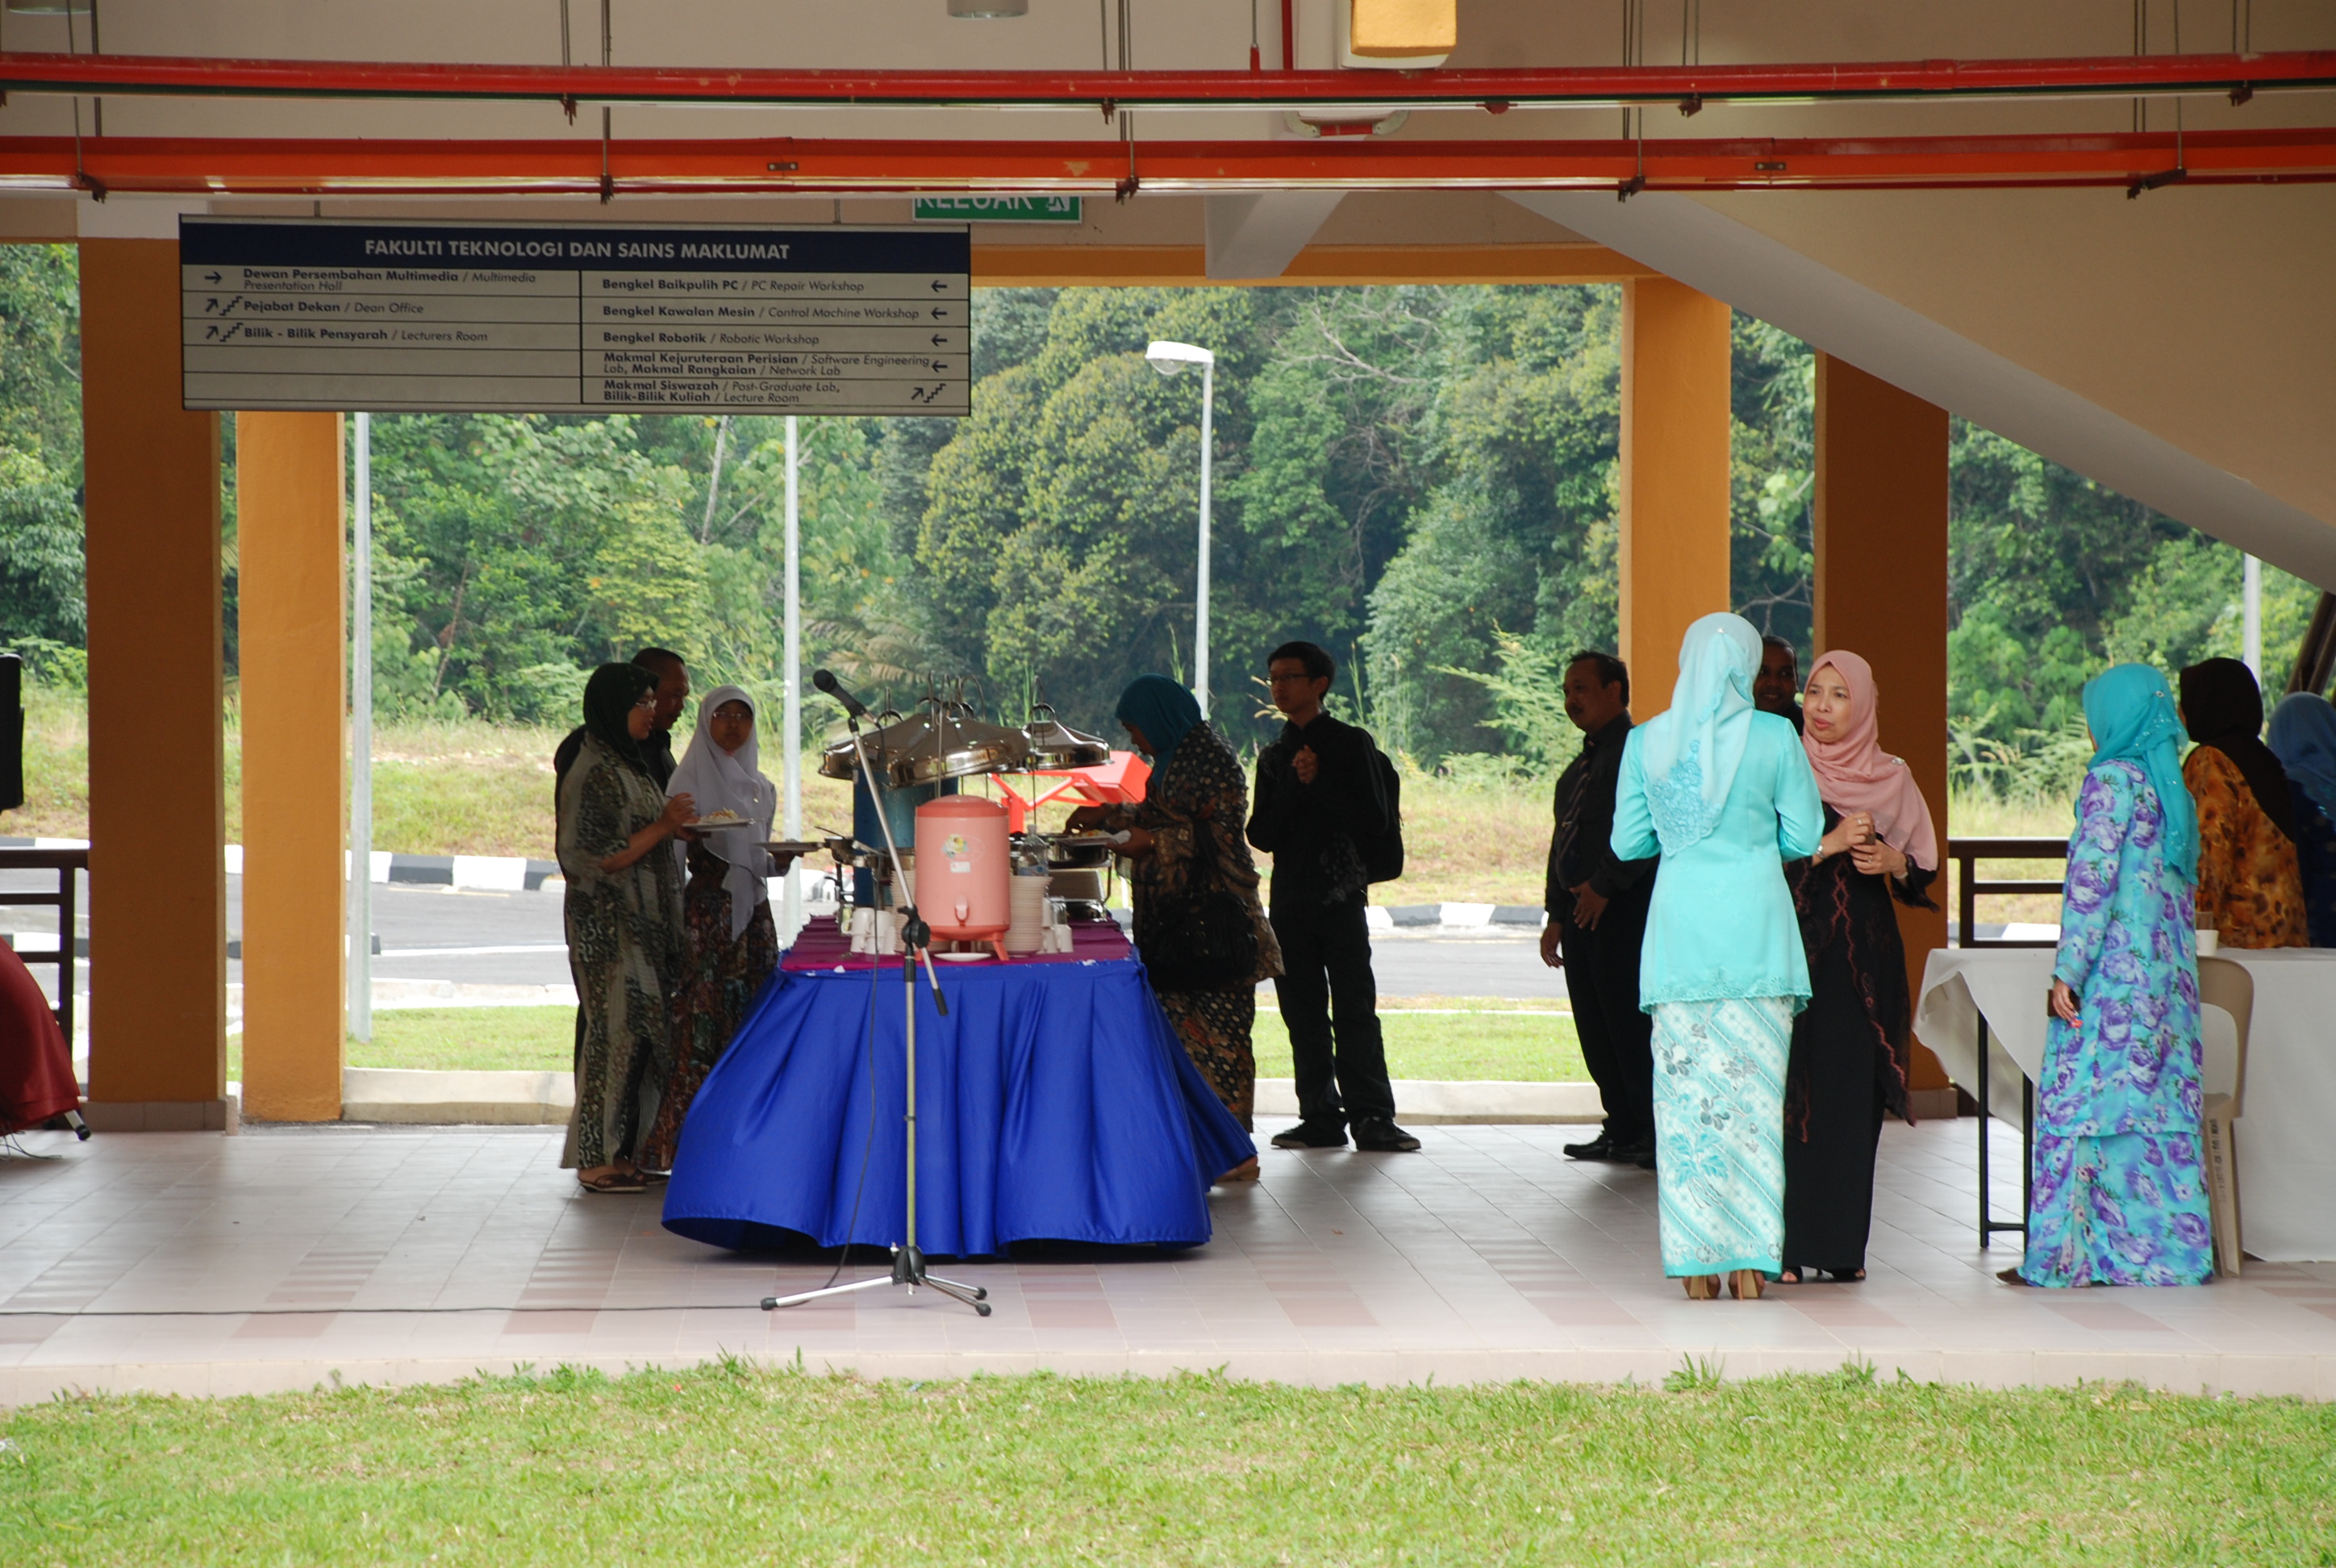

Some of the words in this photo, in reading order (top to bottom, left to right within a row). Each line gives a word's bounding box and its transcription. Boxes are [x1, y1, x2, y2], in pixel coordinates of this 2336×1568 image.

[365, 240, 442, 256] FAKULTI
[448, 241, 563, 257] TEKNOLOGI
[569, 242, 611, 257] DAN
[618, 243, 674, 258] SAINS
[681, 244, 790, 260] MAKLUMAT
[244, 269, 288, 280] Dewan
[293, 269, 382, 281] Persembahan
[386, 270, 458, 282] Multimedia
[472, 272, 536, 283] Multimedia
[244, 280, 315, 291] Presentation
[319, 281, 342, 291] Hall
[603, 279, 654, 291] Bengkel
[658, 280, 718, 292] Baikpulih
[723, 281, 738, 290] PC
[751, 281, 766, 290] PC
[770, 281, 805, 293] Repair
[809, 281, 864, 294] Workshop
[244, 301, 294, 314] Pejabat
[298, 302, 340, 312] Dekan
[354, 302, 385, 313] Dean
[389, 302, 424, 314] Office
[603, 306, 654, 318] Bengkel
[659, 307, 714, 317] Kawalan
[718, 307, 755, 317] Mesin
[769, 307, 809, 318] Control
[812, 307, 861, 319] Machine
[864, 308, 920, 320] Workshop
[244, 327, 273, 338] Bilik
[288, 328, 316, 339] Bilik
[321, 329, 387, 342] Pensyarah
[402, 331, 452, 341] Lecturers
[456, 332, 488, 341] Room
[603, 332, 654, 344] Bengkel
[659, 332, 707, 343] Robotik
[720, 333, 761, 344] Robotic
[765, 334, 820, 346] Workshop
[604, 352, 655, 362] Makmal
[660, 352, 743, 365] Kejuruteraan
[748, 353, 798, 364] Perisian
[811, 354, 860, 365] Software
[864, 355, 930, 367] Engineering
[604, 364, 628, 375] Lab,
[632, 364, 683, 374] Makmal
[687, 365, 756, 377] Rangkaian
[770, 365, 817, 376] Network
[820, 366, 841, 376] Lab
[604, 380, 656, 390] Makmal
[660, 380, 719, 391] Siswazah
[732, 381, 812, 393] Post-Graduate
[816, 382, 841, 394] Lab,
[604, 390, 665, 402] Bilik-Bilik
[670, 391, 711, 402] Kuliah
[724, 393, 764, 402] Lecture
[768, 394, 799, 403] Room
